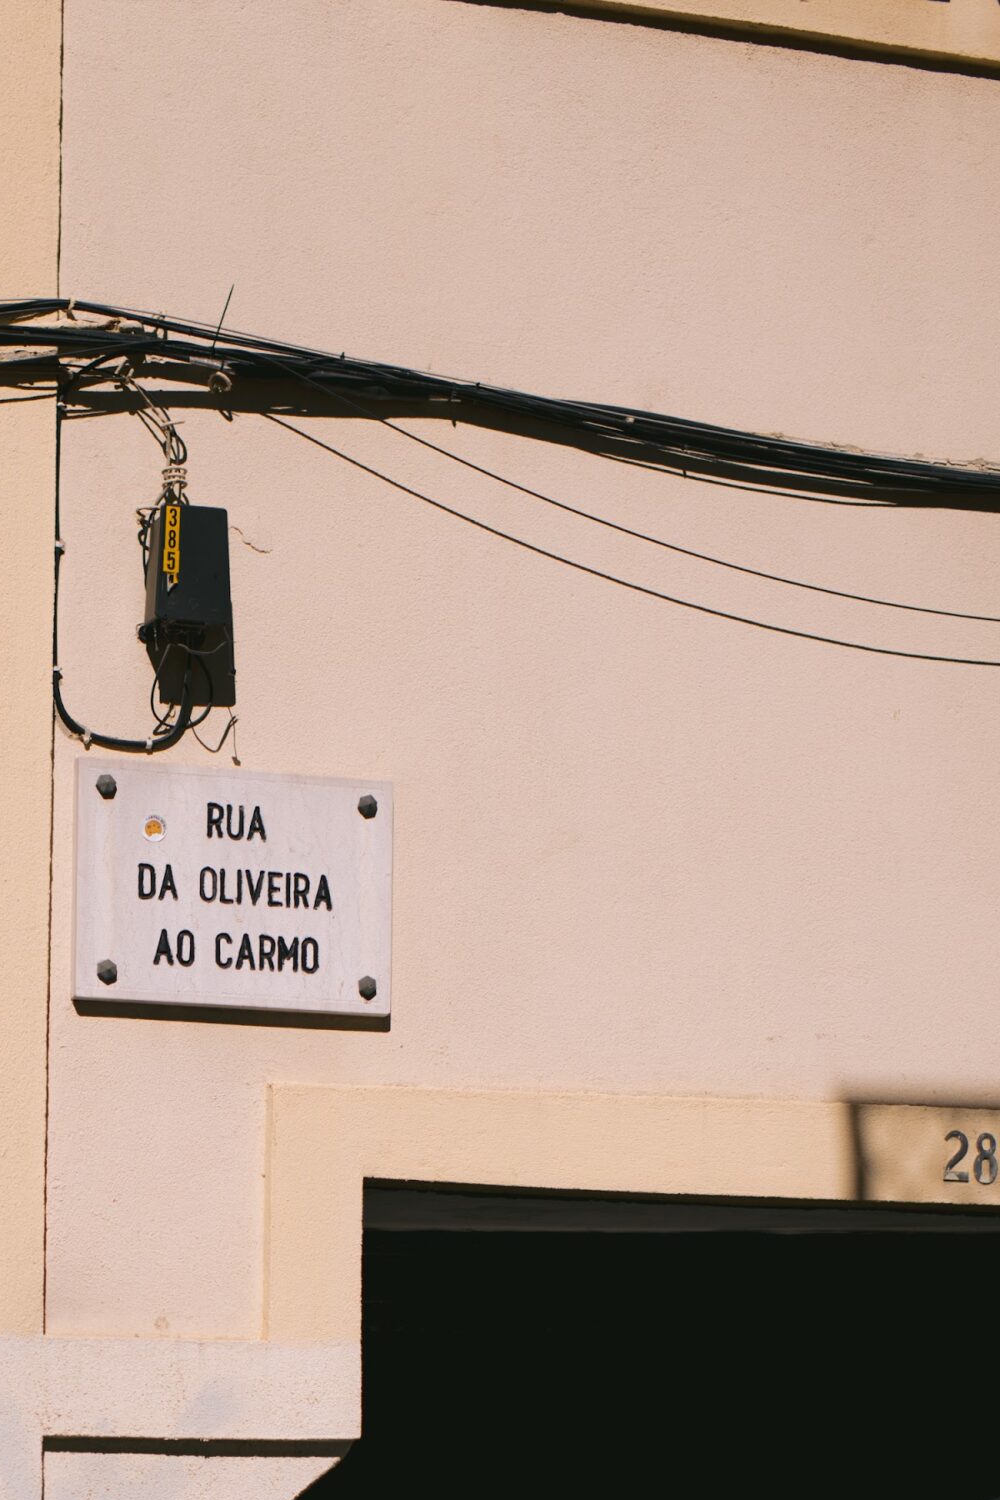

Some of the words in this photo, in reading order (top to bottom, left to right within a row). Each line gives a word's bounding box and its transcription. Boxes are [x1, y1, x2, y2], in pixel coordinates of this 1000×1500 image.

[206, 802, 267, 842] RUA
[137, 863, 179, 901] DA
[199, 866, 333, 911] OLIVEIRA
[152, 928, 196, 967] AO
[214, 932, 320, 974] CARMO
[942, 1130, 998, 1185] 28
